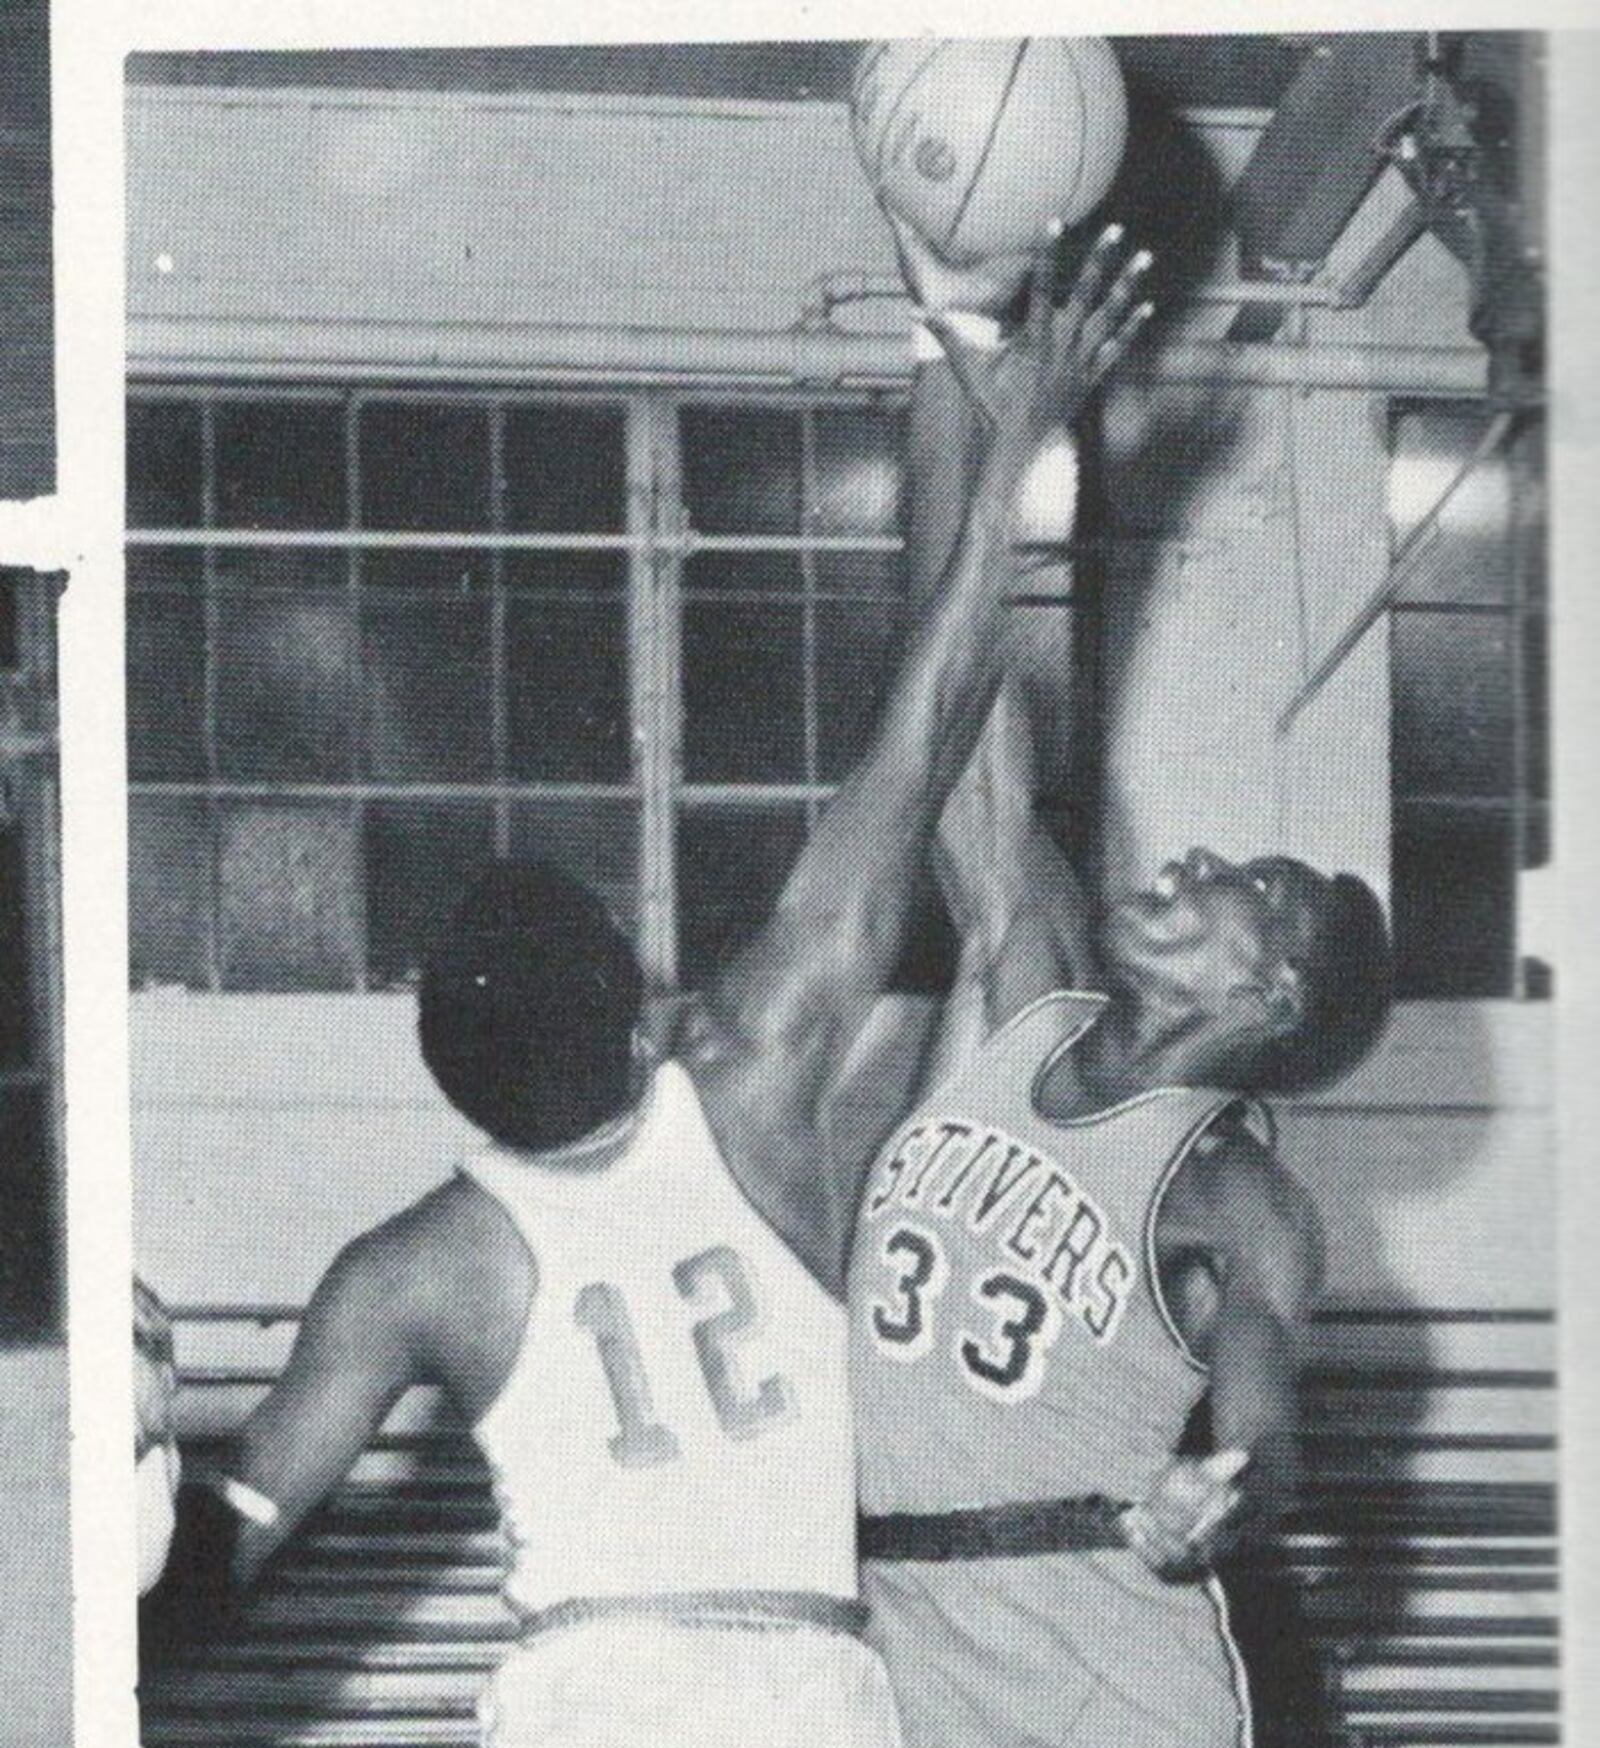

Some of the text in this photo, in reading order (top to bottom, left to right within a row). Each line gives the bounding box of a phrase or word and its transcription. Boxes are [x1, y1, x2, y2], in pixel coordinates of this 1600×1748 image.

[868, 1221, 1053, 1395] 33
[869, 1119, 1133, 1342] STIVERS
[573, 1244, 788, 1469] 12
